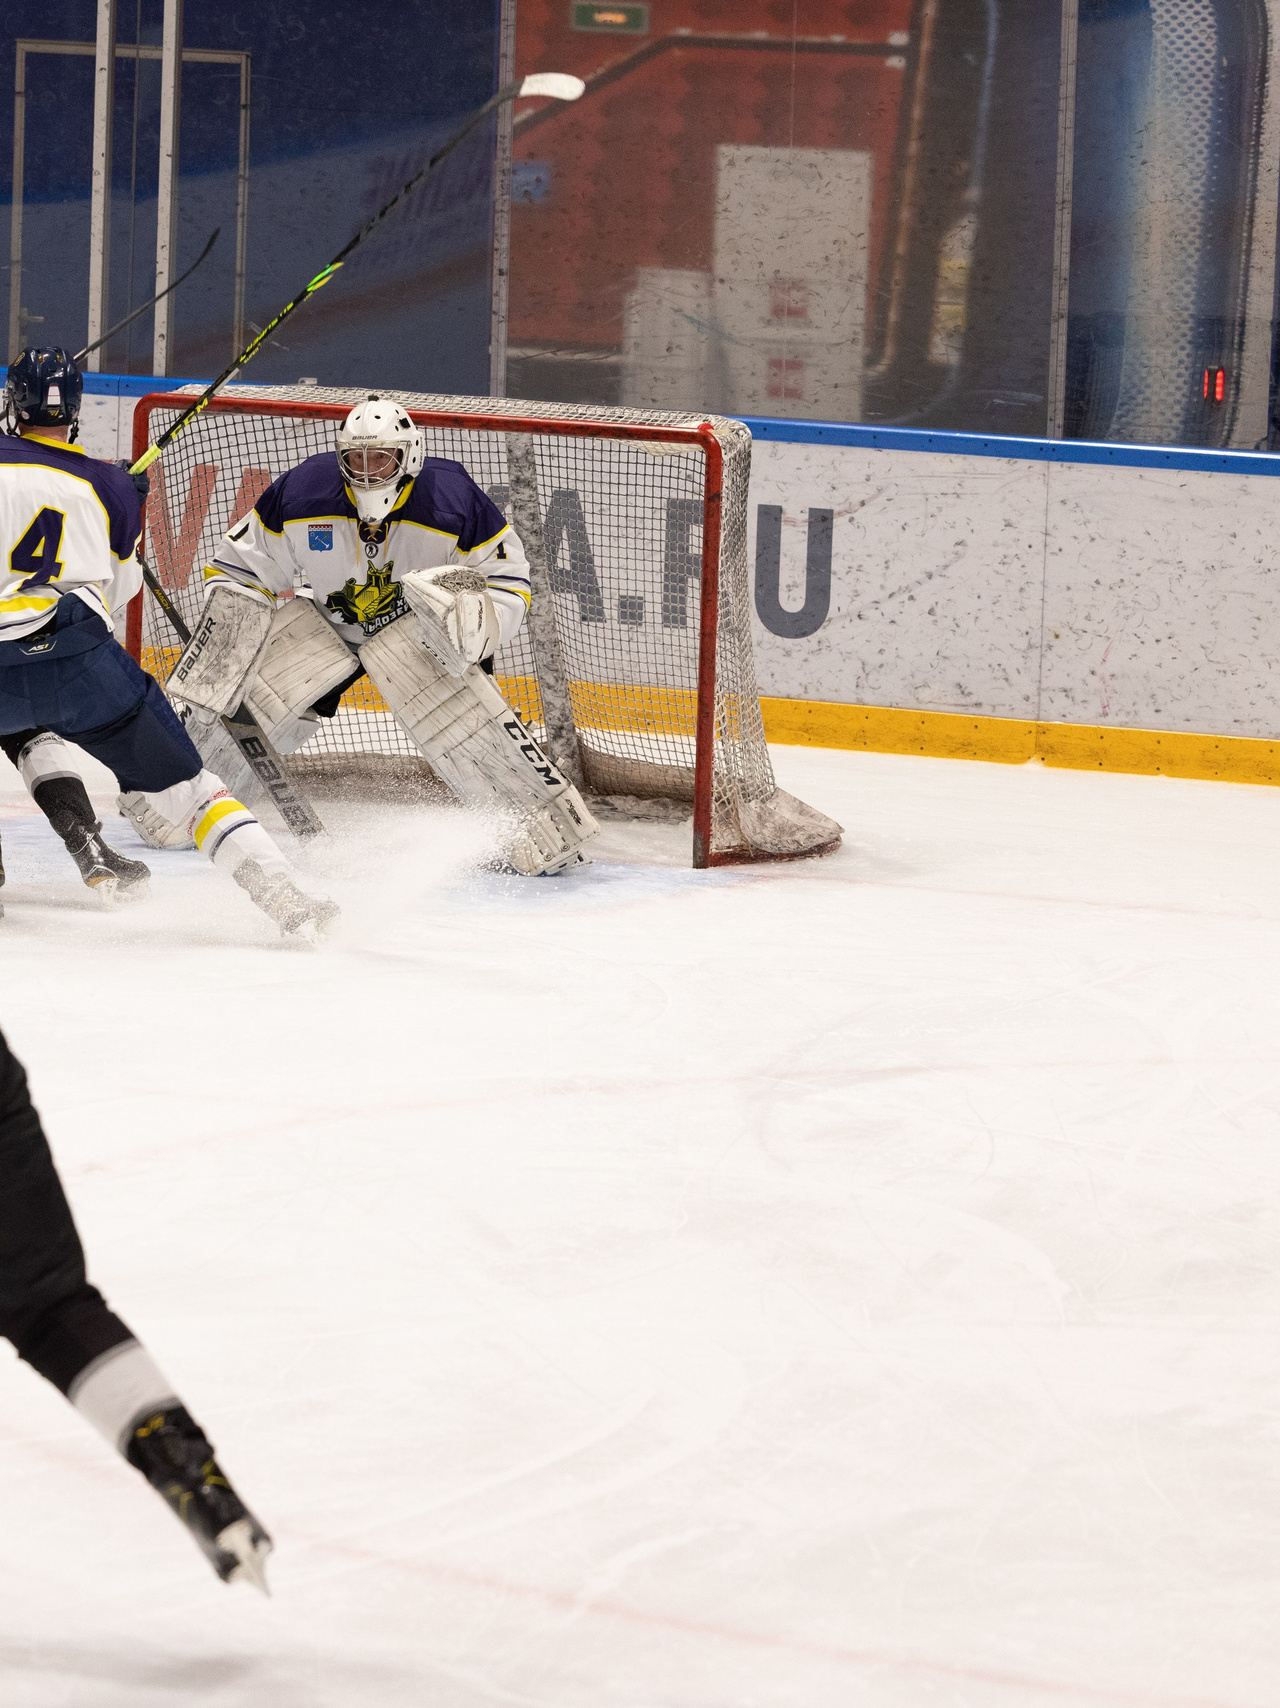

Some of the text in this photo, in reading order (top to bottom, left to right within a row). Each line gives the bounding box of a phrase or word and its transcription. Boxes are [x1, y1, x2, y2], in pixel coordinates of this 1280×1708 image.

[9, 505, 67, 593] 4
[176, 615, 217, 683] BAUER
[503, 718, 562, 787] CCM
